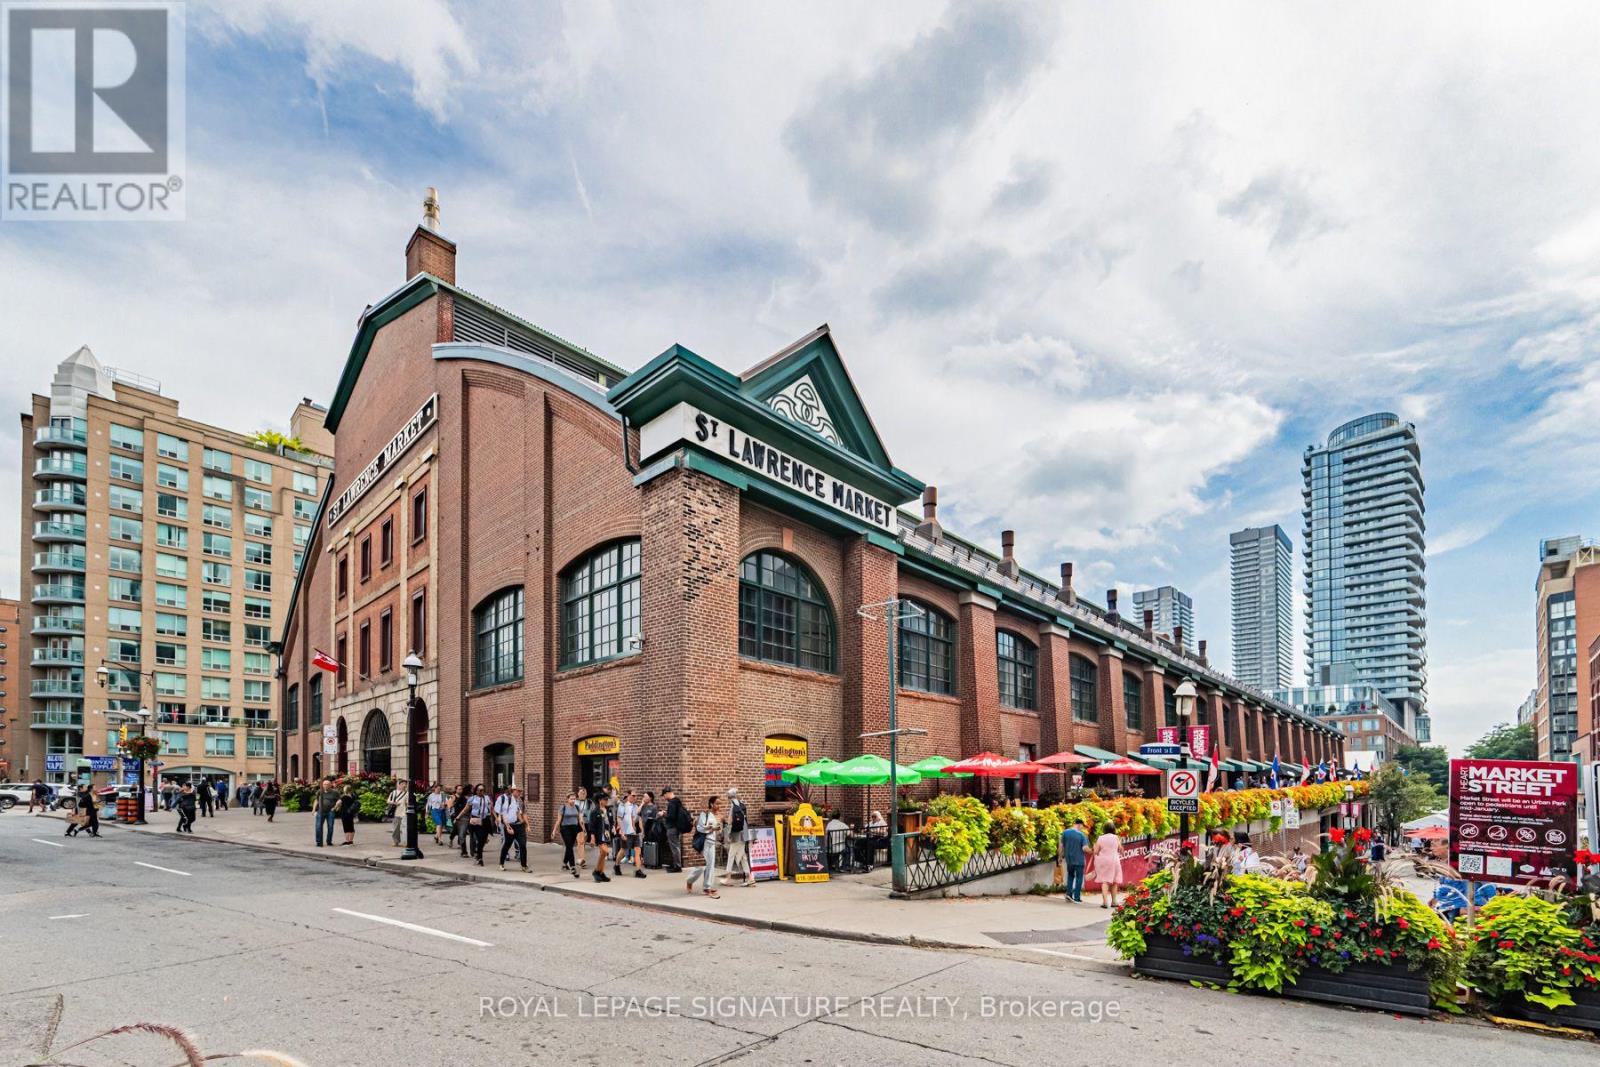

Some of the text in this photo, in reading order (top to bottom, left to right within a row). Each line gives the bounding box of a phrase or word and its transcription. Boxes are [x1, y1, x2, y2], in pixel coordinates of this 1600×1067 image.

[342, 461, 379, 511] LAWRENCE
[383, 411, 424, 467] MARKET
[729, 428, 826, 499] LAWRENCE
[832, 480, 892, 528] MARKET
[766, 745, 806, 758] Paddington's
[47, 762, 64, 770] VAPE
[1468, 766, 1567, 784] MARKET
[1460, 766, 1469, 790] HEART
[1468, 780, 1557, 796] STREET
